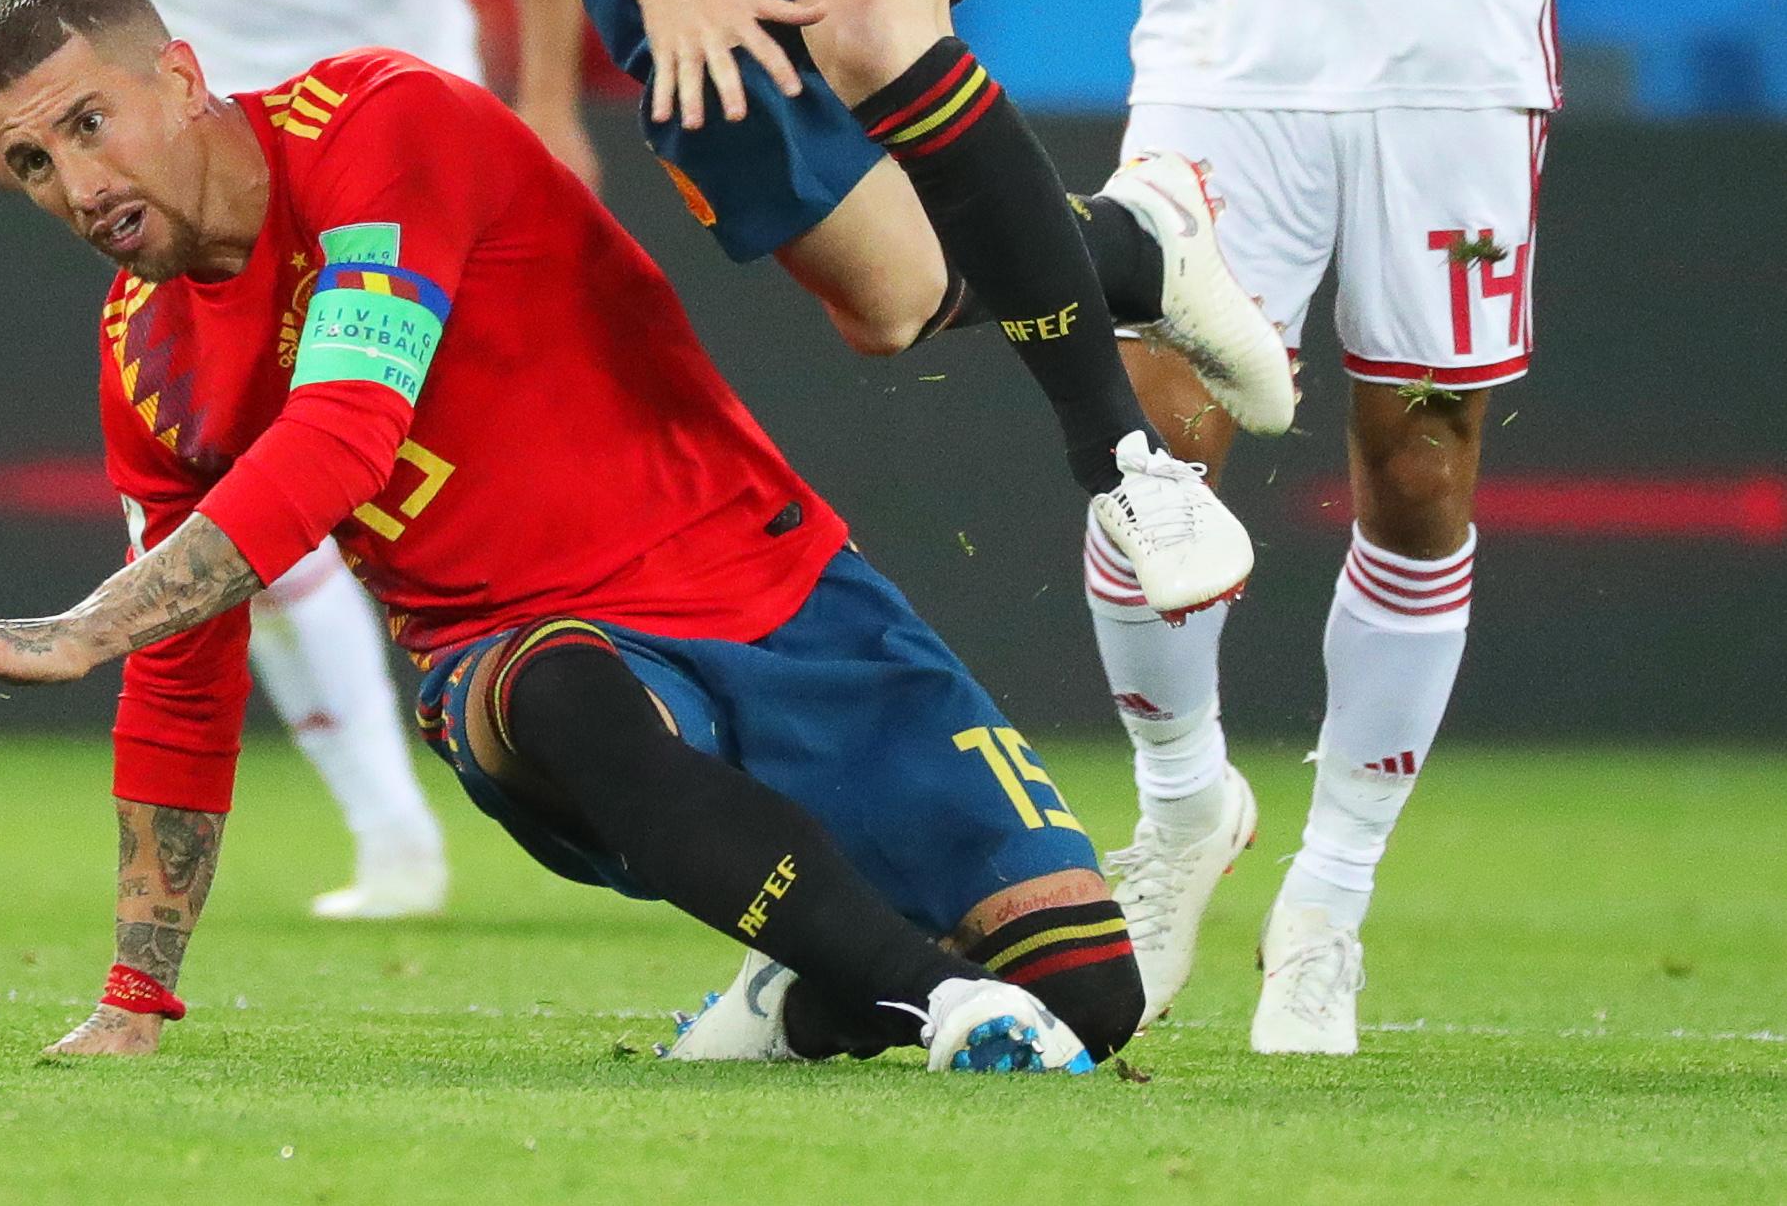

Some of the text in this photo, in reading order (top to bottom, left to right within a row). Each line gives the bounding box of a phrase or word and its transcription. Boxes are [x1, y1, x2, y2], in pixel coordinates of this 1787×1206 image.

[1000, 302, 1080, 342] RFEF
[1427, 228, 1530, 355] 14
[317, 307, 432, 350] LIVING
[383, 365, 417, 398] FIFA
[951, 726, 1089, 835] 15
[737, 854, 797, 938] RFEF
